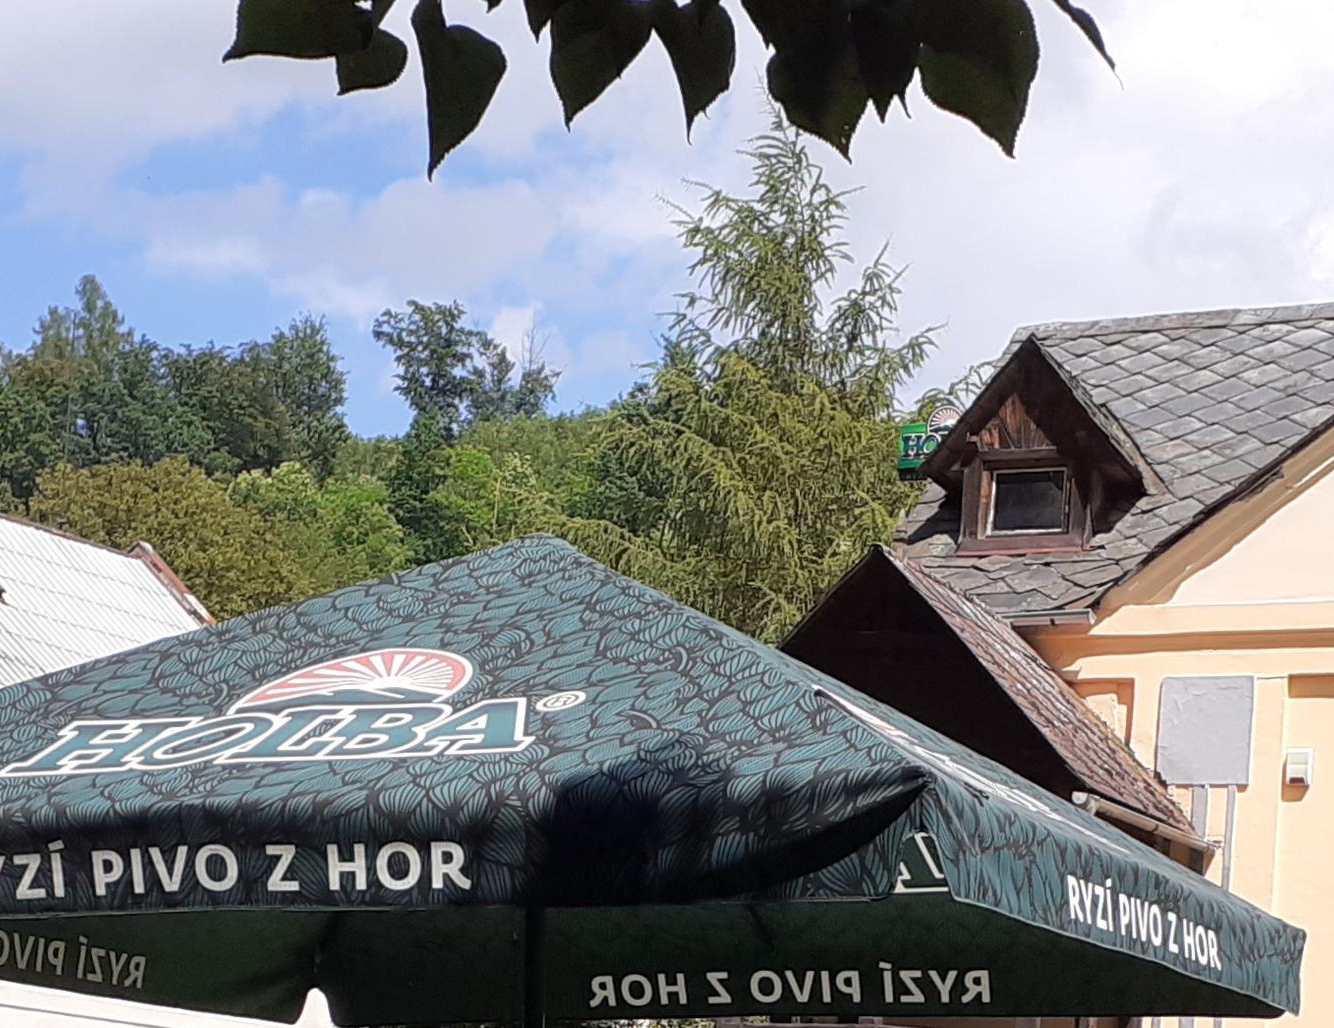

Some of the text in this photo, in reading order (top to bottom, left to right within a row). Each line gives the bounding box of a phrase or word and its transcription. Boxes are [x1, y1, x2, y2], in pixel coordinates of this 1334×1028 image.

[92, 843, 239, 895] PIVO
[265, 843, 301, 892] Z
[325, 842, 471, 890] HOR
[1067, 874, 1222, 971] RYZÍ PIVO Z HOR
